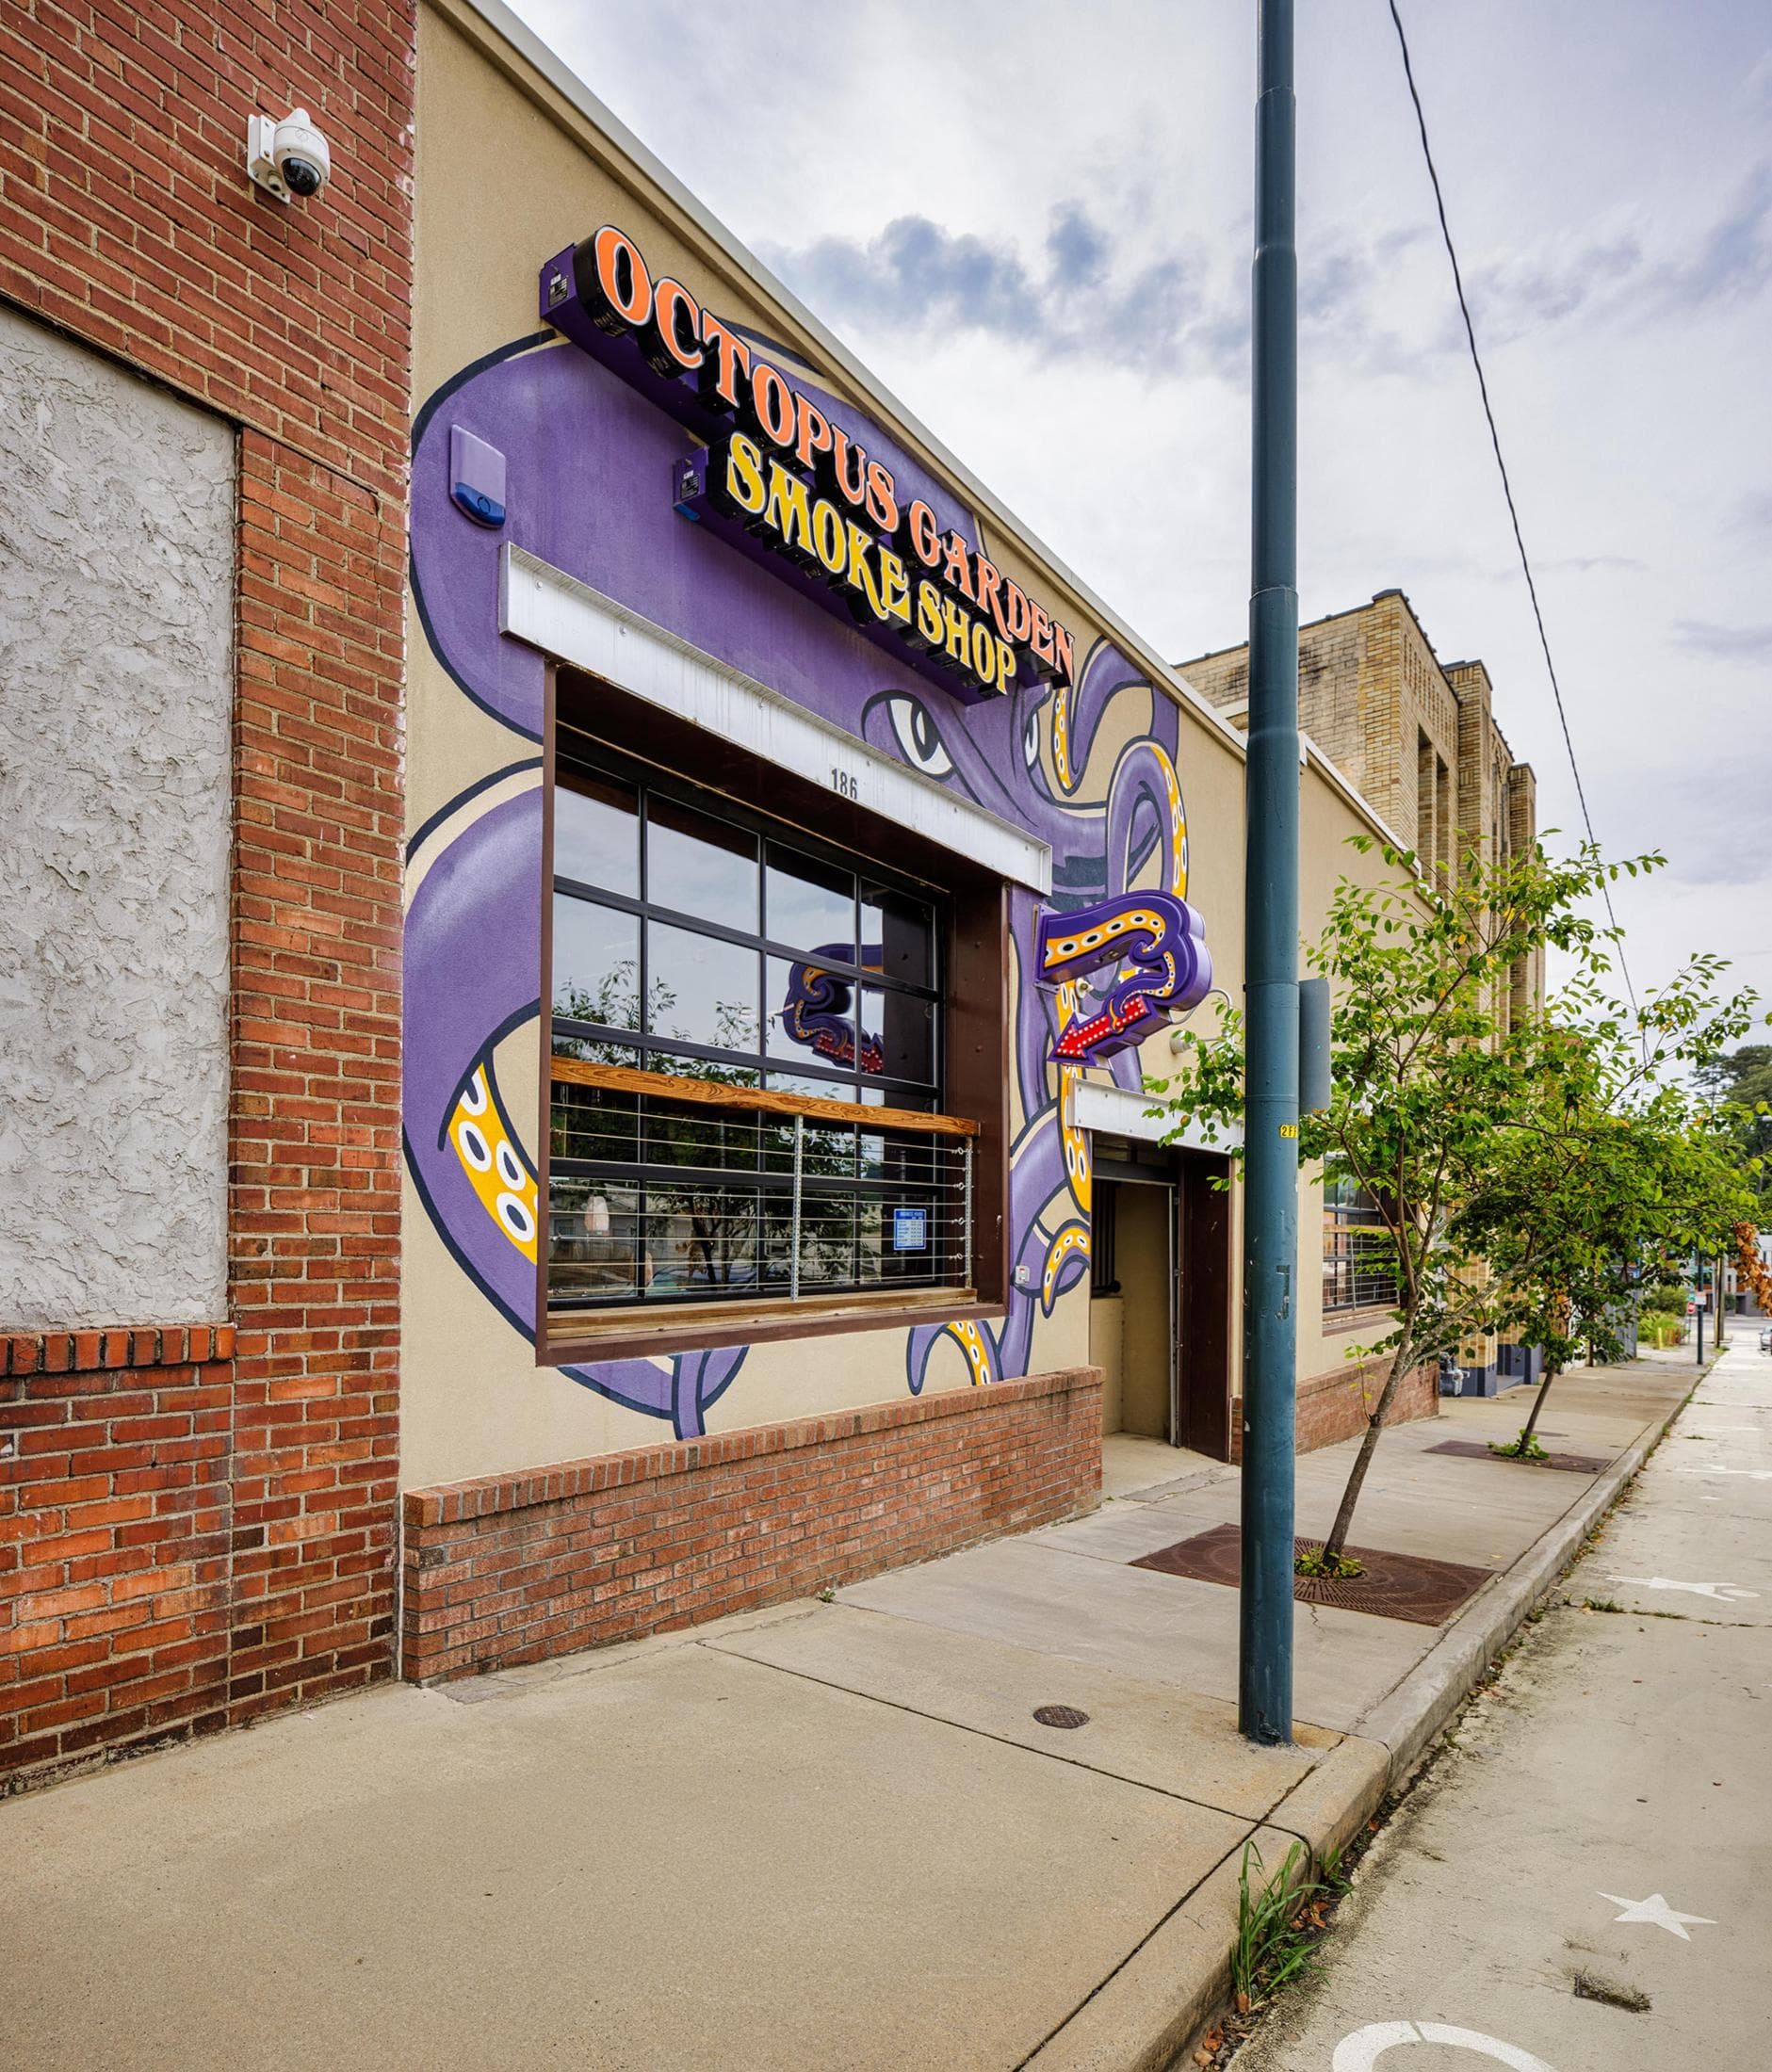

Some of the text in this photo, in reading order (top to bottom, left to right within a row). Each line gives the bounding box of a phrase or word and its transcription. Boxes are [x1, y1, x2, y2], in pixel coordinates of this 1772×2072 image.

[593, 224, 1075, 688] OCTOPUS GARDEN
[725, 430, 1017, 697] SMOKE SHOP
[831, 768, 857, 800] 186
